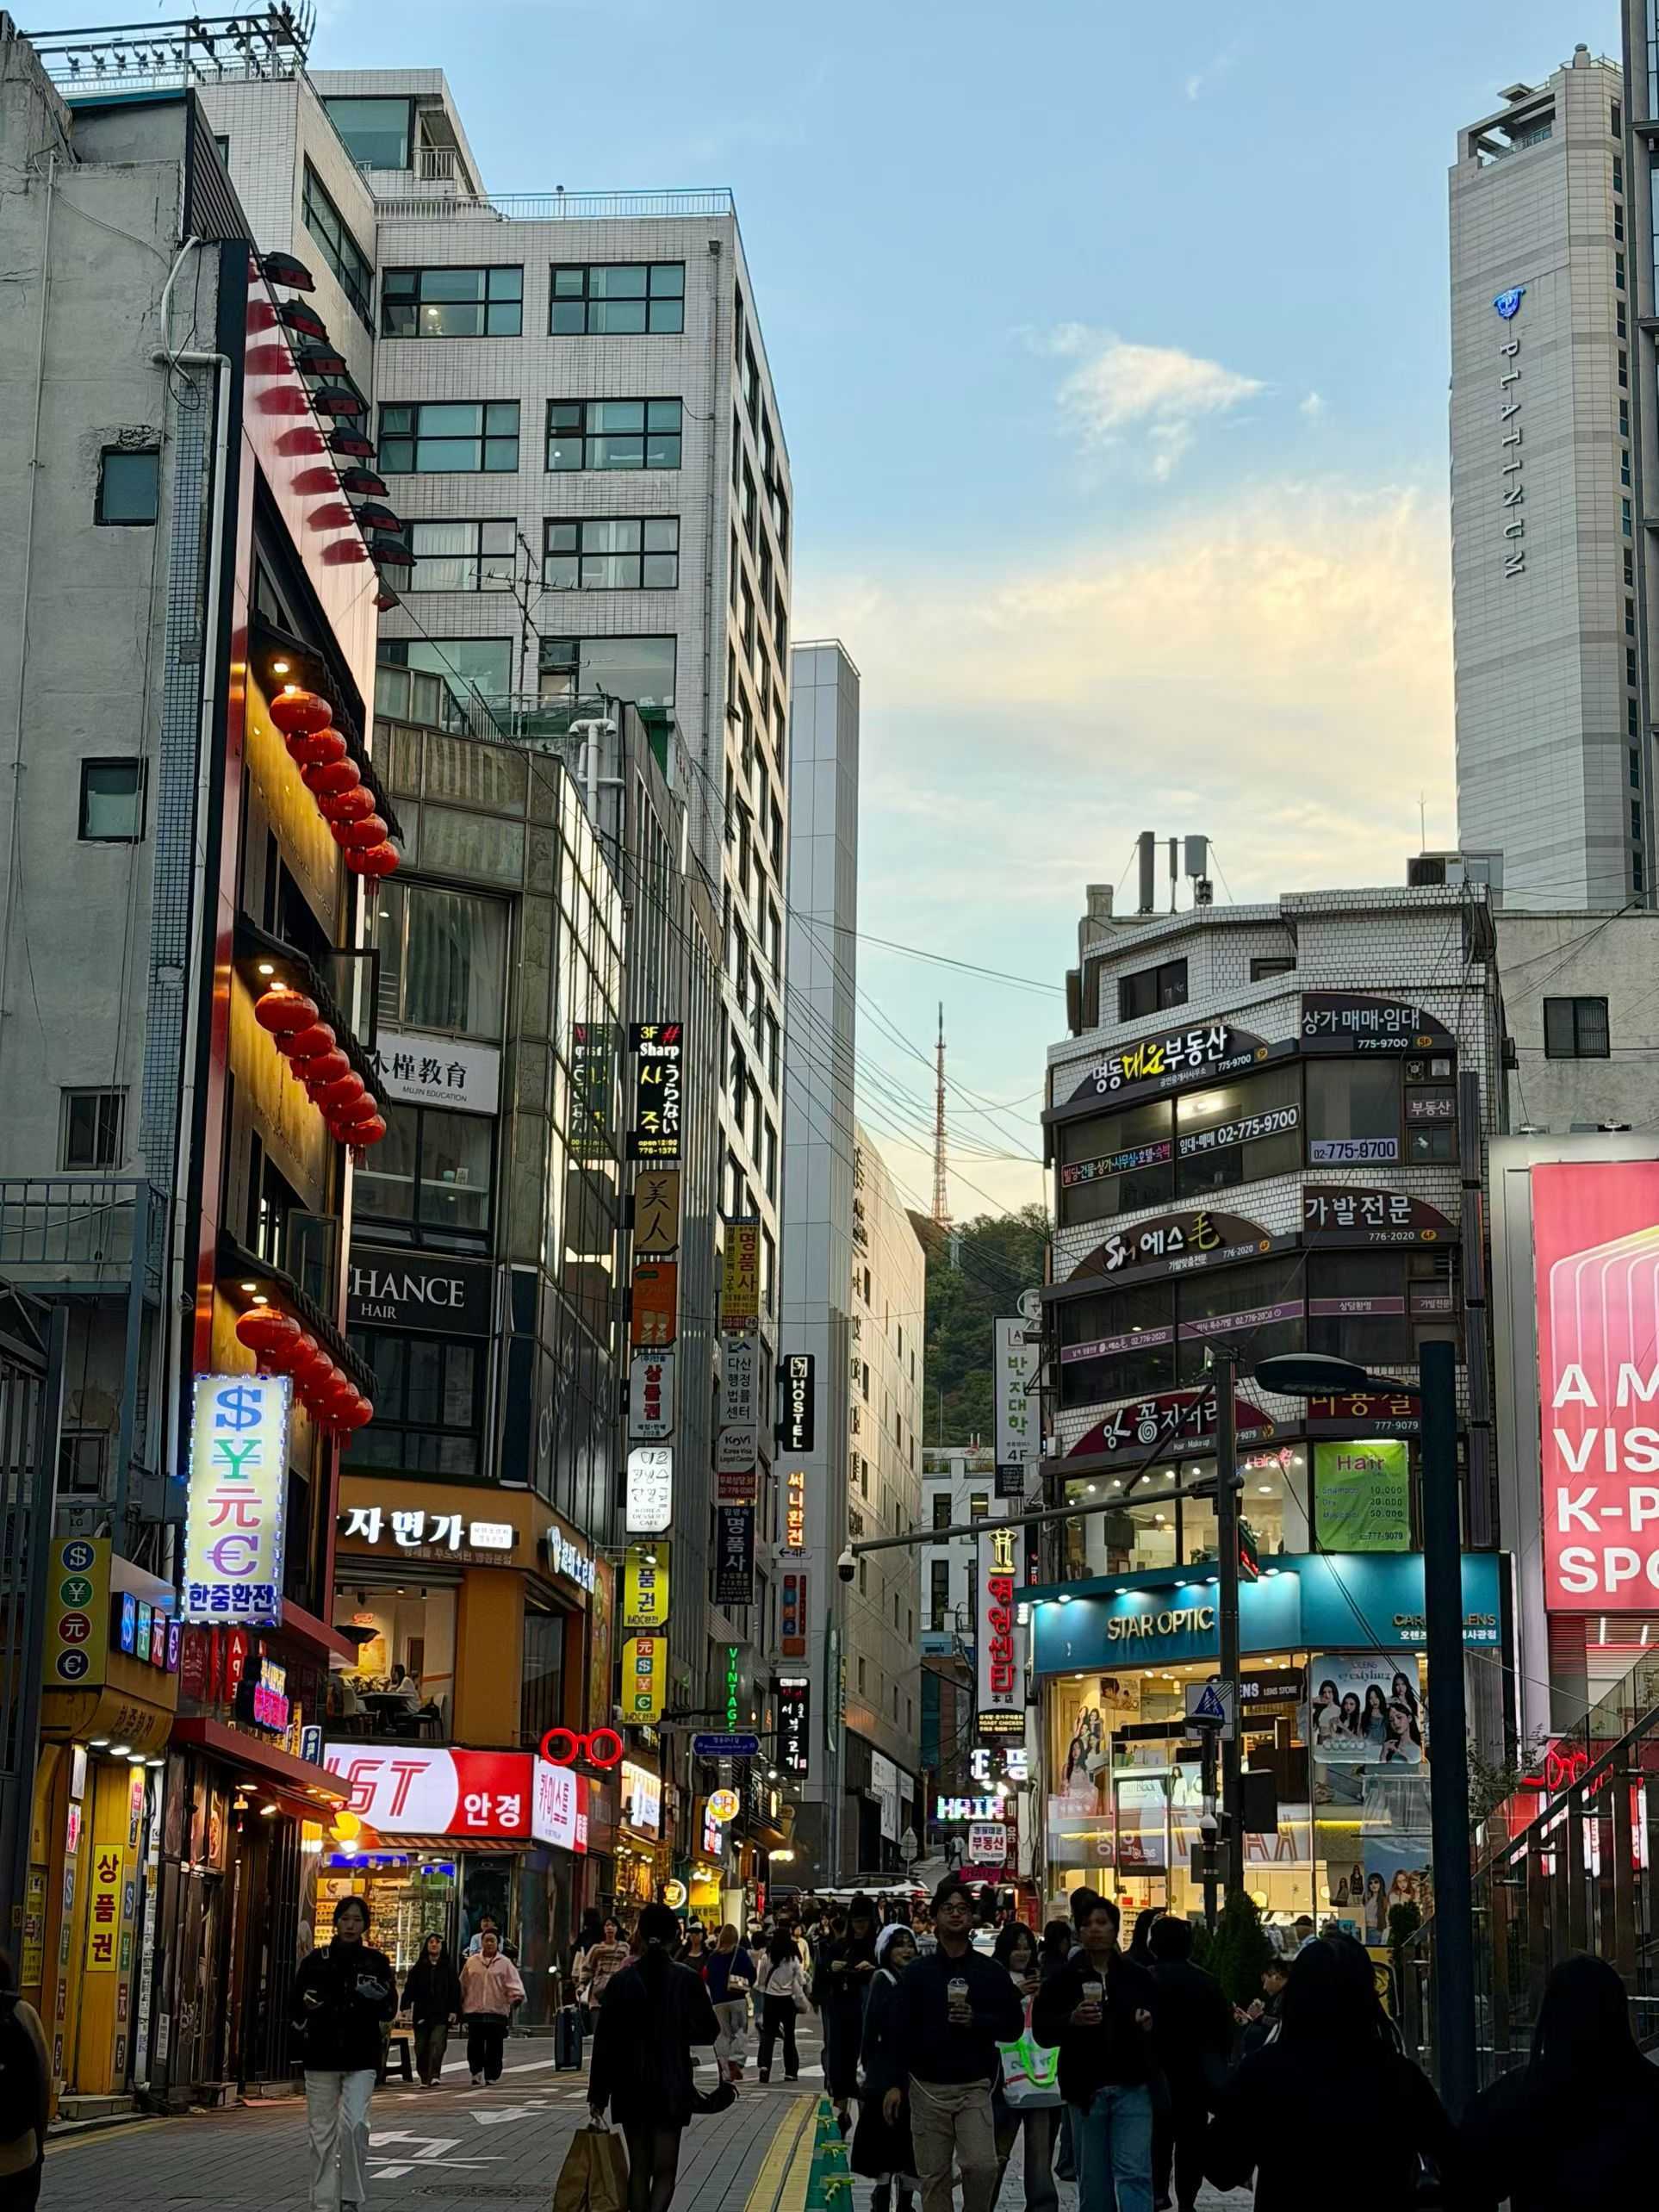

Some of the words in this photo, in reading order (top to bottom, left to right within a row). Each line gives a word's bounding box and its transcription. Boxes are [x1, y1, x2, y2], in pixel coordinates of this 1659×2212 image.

[1500, 339, 1525, 579] PLATINUM
[640, 1026, 659, 1039] 3F
[1302, 1010, 1338, 1035] 상가
[639, 1041, 680, 1060] Sharp
[1357, 1038, 1409, 1049] 775-9700
[1217, 1053, 1252, 1072] 775-9700
[401, 1085, 426, 1097] MUJIN
[426, 1090, 468, 1103] EDUCATION
[640, 1064, 662, 1134] 사주
[662, 1064, 680, 1134] うらない
[1411, 1101, 1451, 1116] 부동산
[1217, 1108, 1298, 1145] 02-775-9700
[1314, 1140, 1396, 1160] 02-775-9700
[642, 1179, 671, 1242] 美人
[1304, 1195, 1413, 1227] 가발전문
[1369, 1232, 1415, 1241] 776-2020
[737, 1232, 759, 1293] 명품사
[1222, 1244, 1254, 1259] 776-2020
[346, 1266, 466, 1308] HANCE
[361, 1302, 398, 1320] HAIR
[1552, 1364, 1599, 1407] A
[792, 1379, 806, 1448] HOSTEL
[1376, 1421, 1419, 1431] 777-9079
[1008, 1449, 1028, 1462] 4F
[1336, 1454, 1385, 1471] Hair
[70, 1519, 84, 1527] LG
[726, 1517, 746, 1572] 명품사
[1557, 1545, 1659, 1594] SP
[188, 1583, 275, 1612] 한중환전
[1107, 1613, 1155, 1641] STAR
[1157, 1606, 1216, 1633] OPTIC
[463, 1792, 521, 1828] 안경
[936, 1796, 1005, 1820] HAIR
[972, 1836, 1004, 1851] 부동산
[91, 1854, 120, 1962] 상품권
